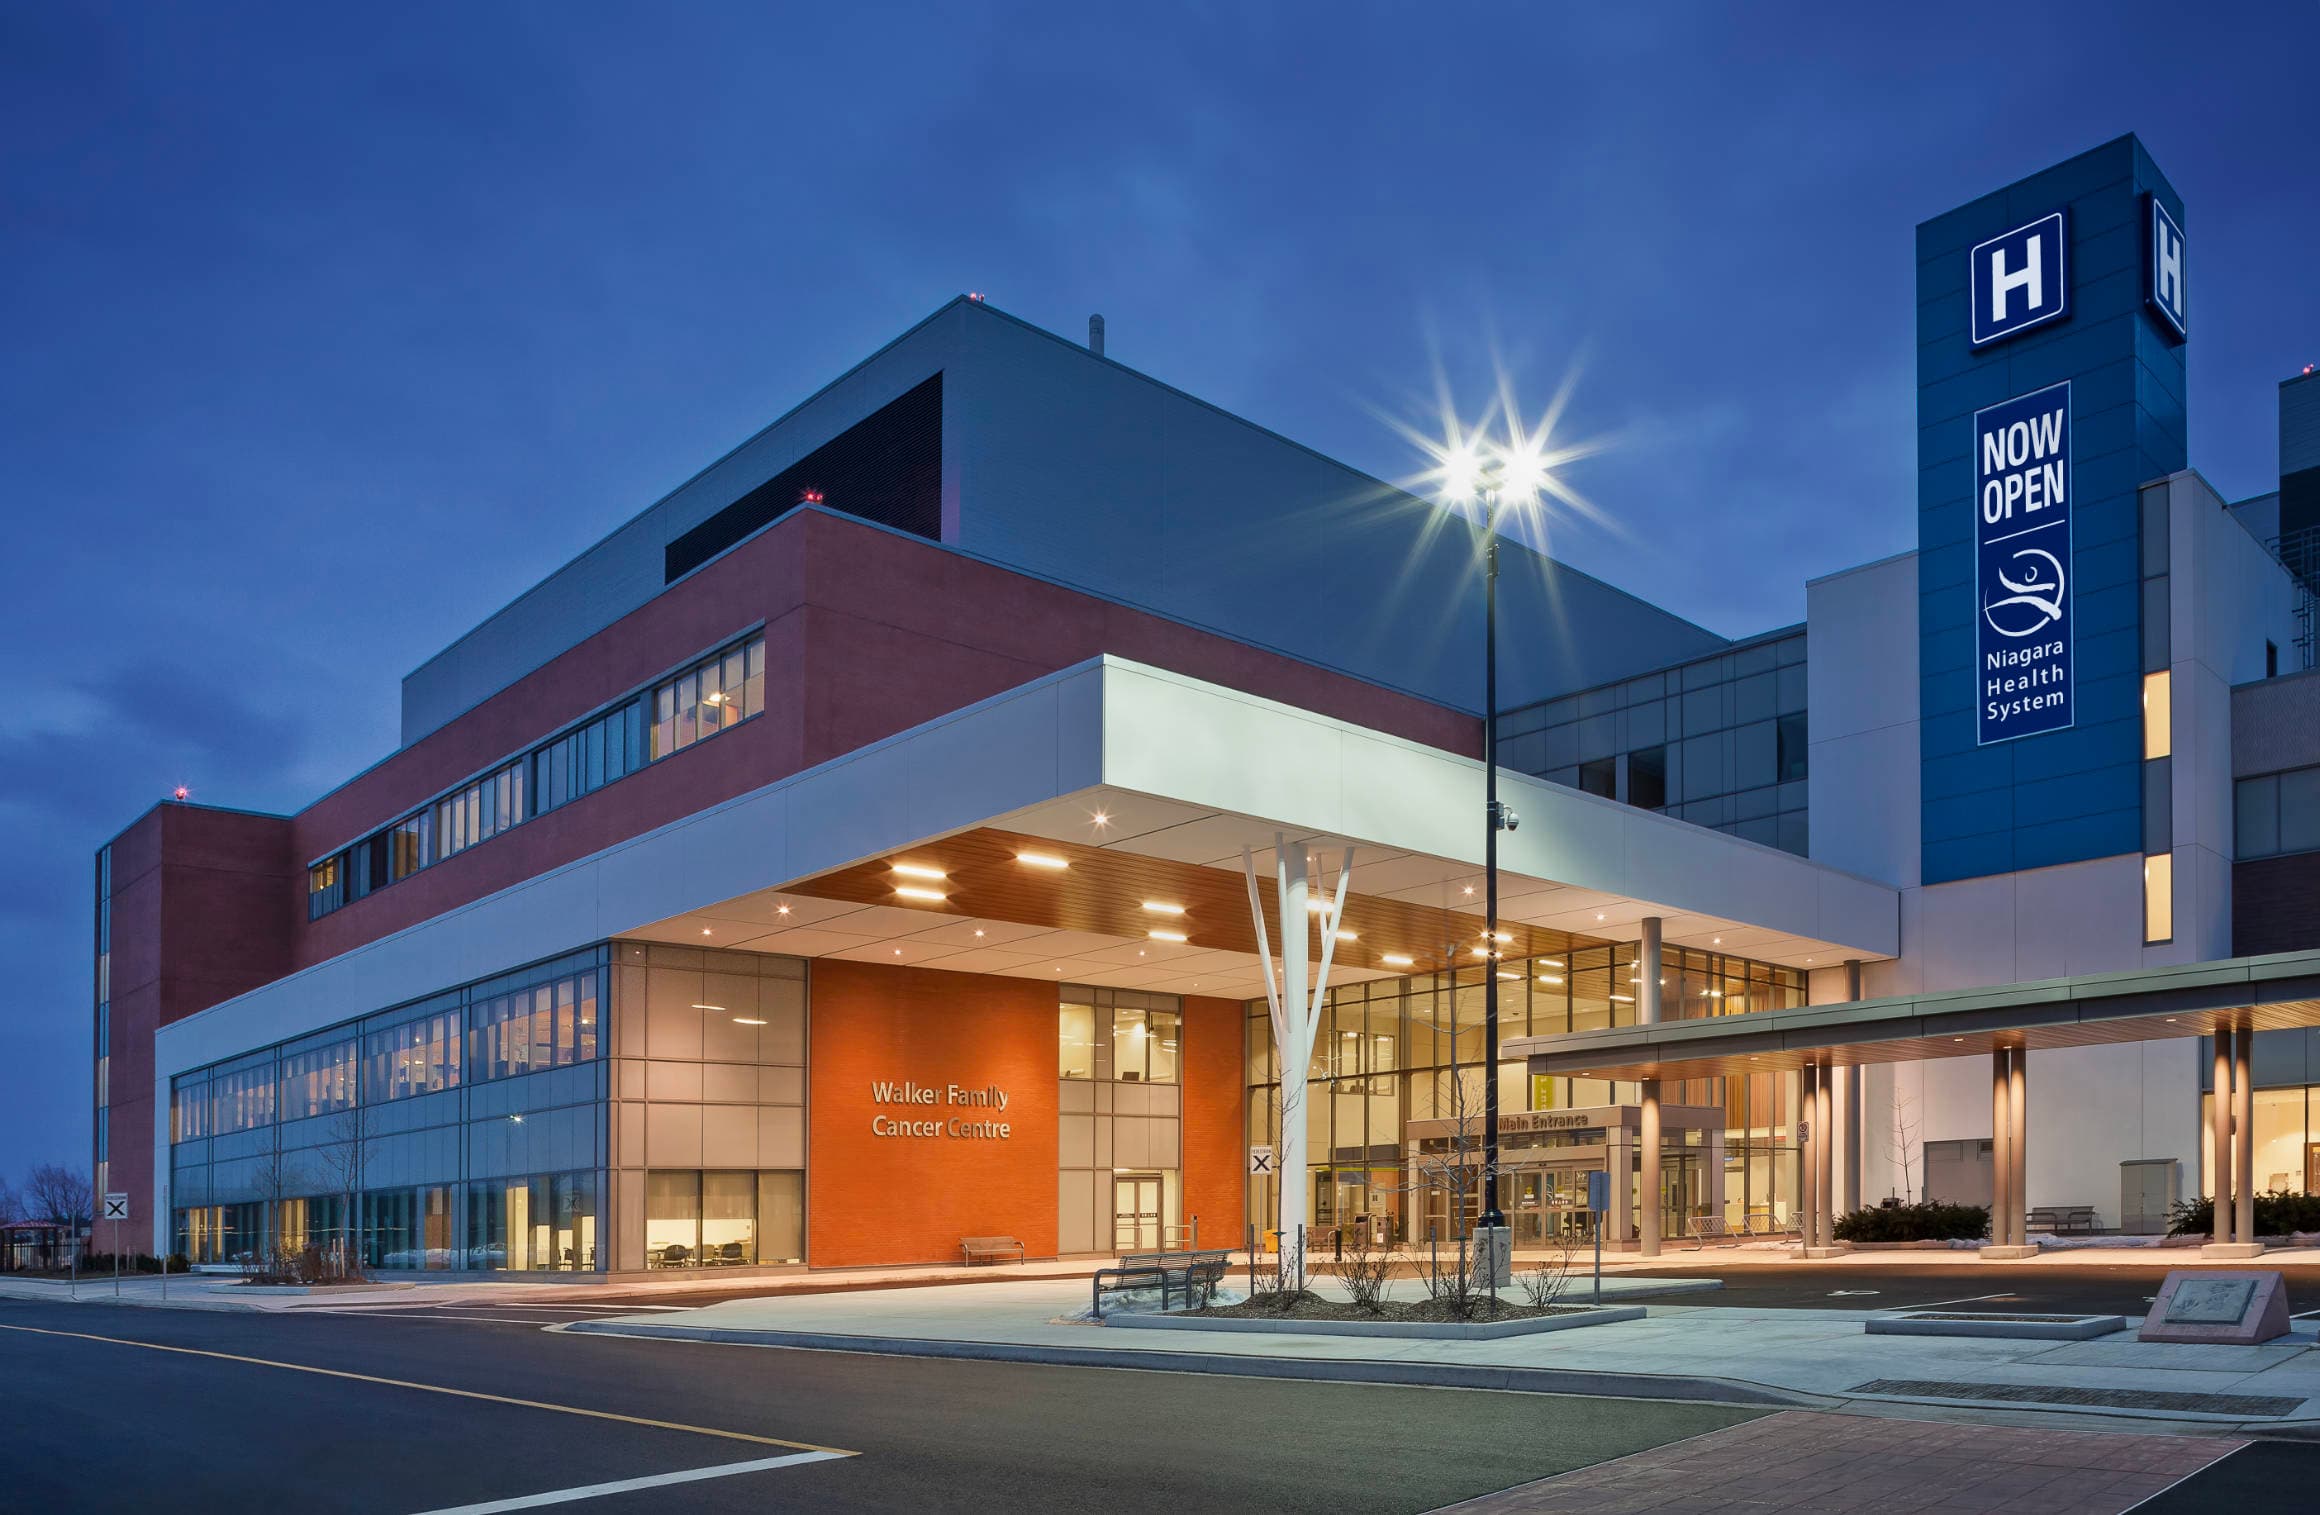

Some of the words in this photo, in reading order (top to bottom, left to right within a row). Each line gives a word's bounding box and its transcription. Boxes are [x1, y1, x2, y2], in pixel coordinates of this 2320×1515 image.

[1991, 233, 2042, 322] H
[2158, 217, 2182, 318] H
[1983, 408, 2064, 476] NOW
[1983, 459, 2065, 524] OPEN
[1987, 640, 2064, 671] Niagara
[1987, 664, 2064, 697] Health
[1987, 691, 2064, 722] System
[872, 1081, 942, 1105] Walker
[947, 1084, 1009, 1112] Family
[872, 1115, 943, 1137] Cancer
[947, 1117, 1011, 1138] Centre
[1499, 1116, 1529, 1131] Main
[1532, 1113, 1589, 1129] Entrance
